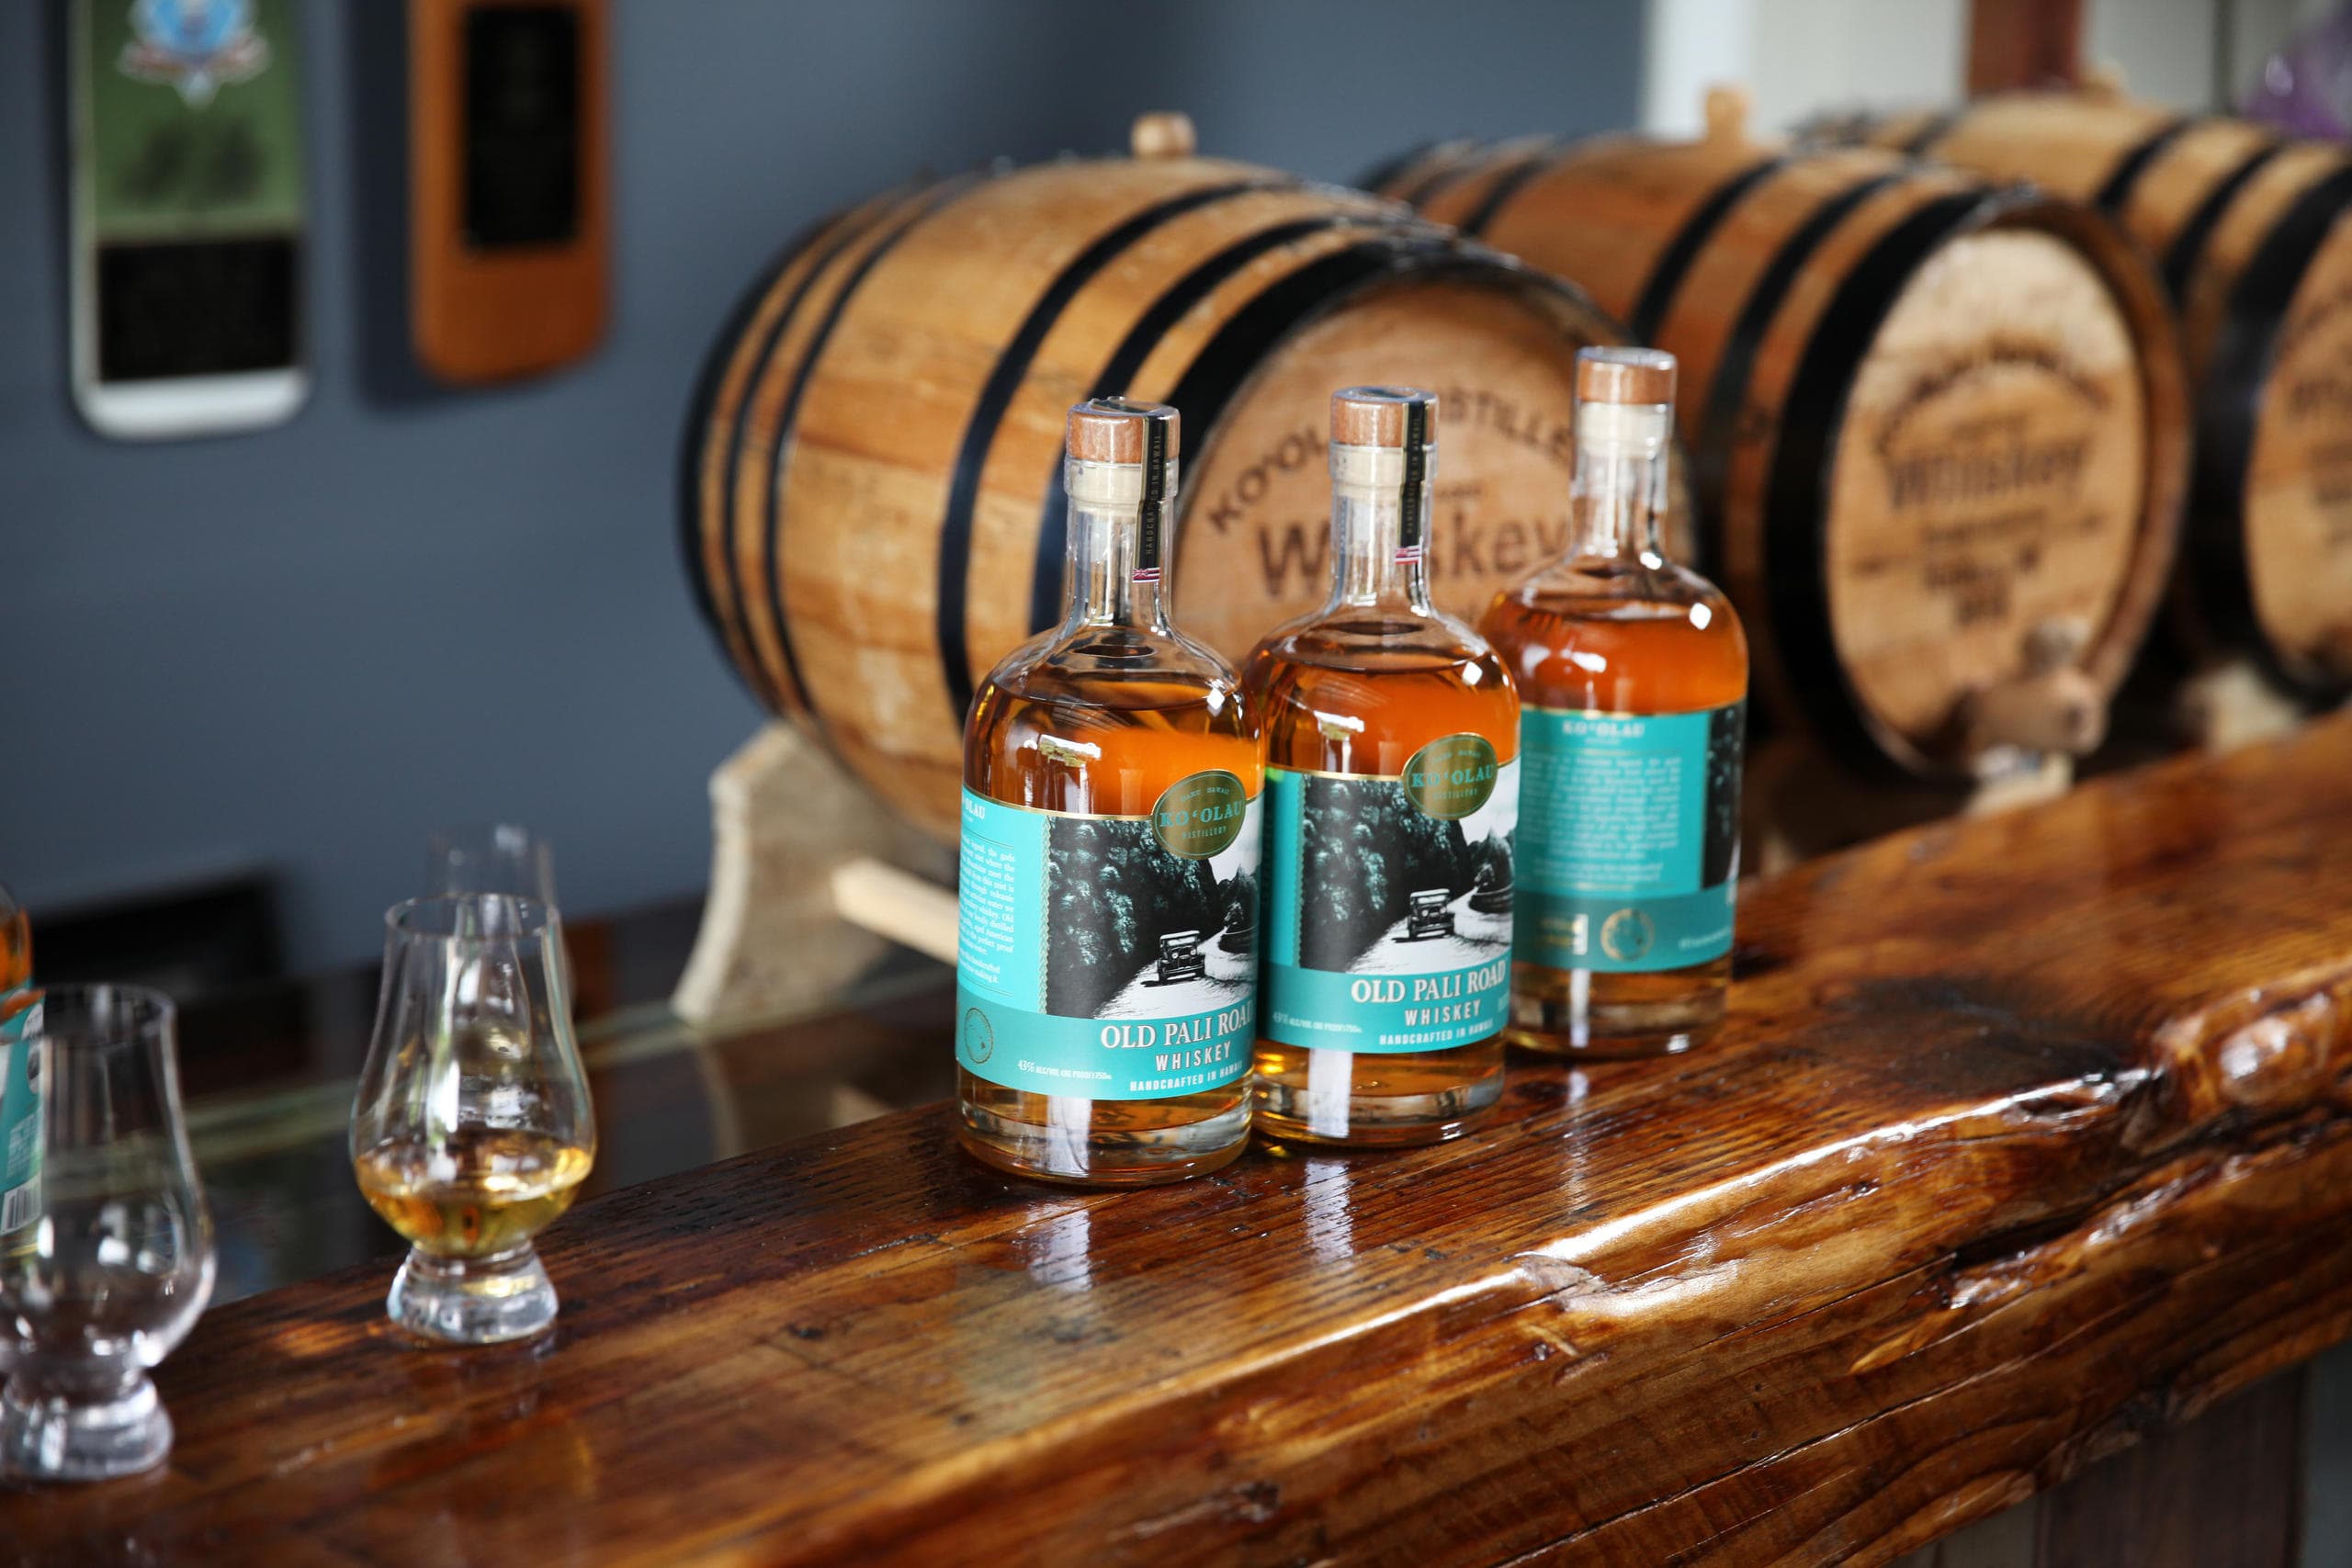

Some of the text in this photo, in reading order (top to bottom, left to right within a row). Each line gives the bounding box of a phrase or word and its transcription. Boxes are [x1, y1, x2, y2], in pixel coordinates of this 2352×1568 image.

[1211, 427, 1325, 532] KO'OL
[1159, 800, 1242, 828] KO'OLAU
[1351, 960, 1507, 1003] OLD PALI ROAD
[1404, 999, 1481, 1027] WHISKEY
[1100, 1024, 1157, 1049] OLD
[1163, 1017, 1212, 1046] PALI
[1379, 1030, 1453, 1045] HANDCRAFTED
[1455, 1026, 1466, 1038] IN
[1017, 1059, 1036, 1073] 43%
[1155, 1041, 1232, 1072] WHISKEY
[1130, 1073, 1204, 1092] HANDCRAFTED
[1207, 1070, 1217, 1082] IN
